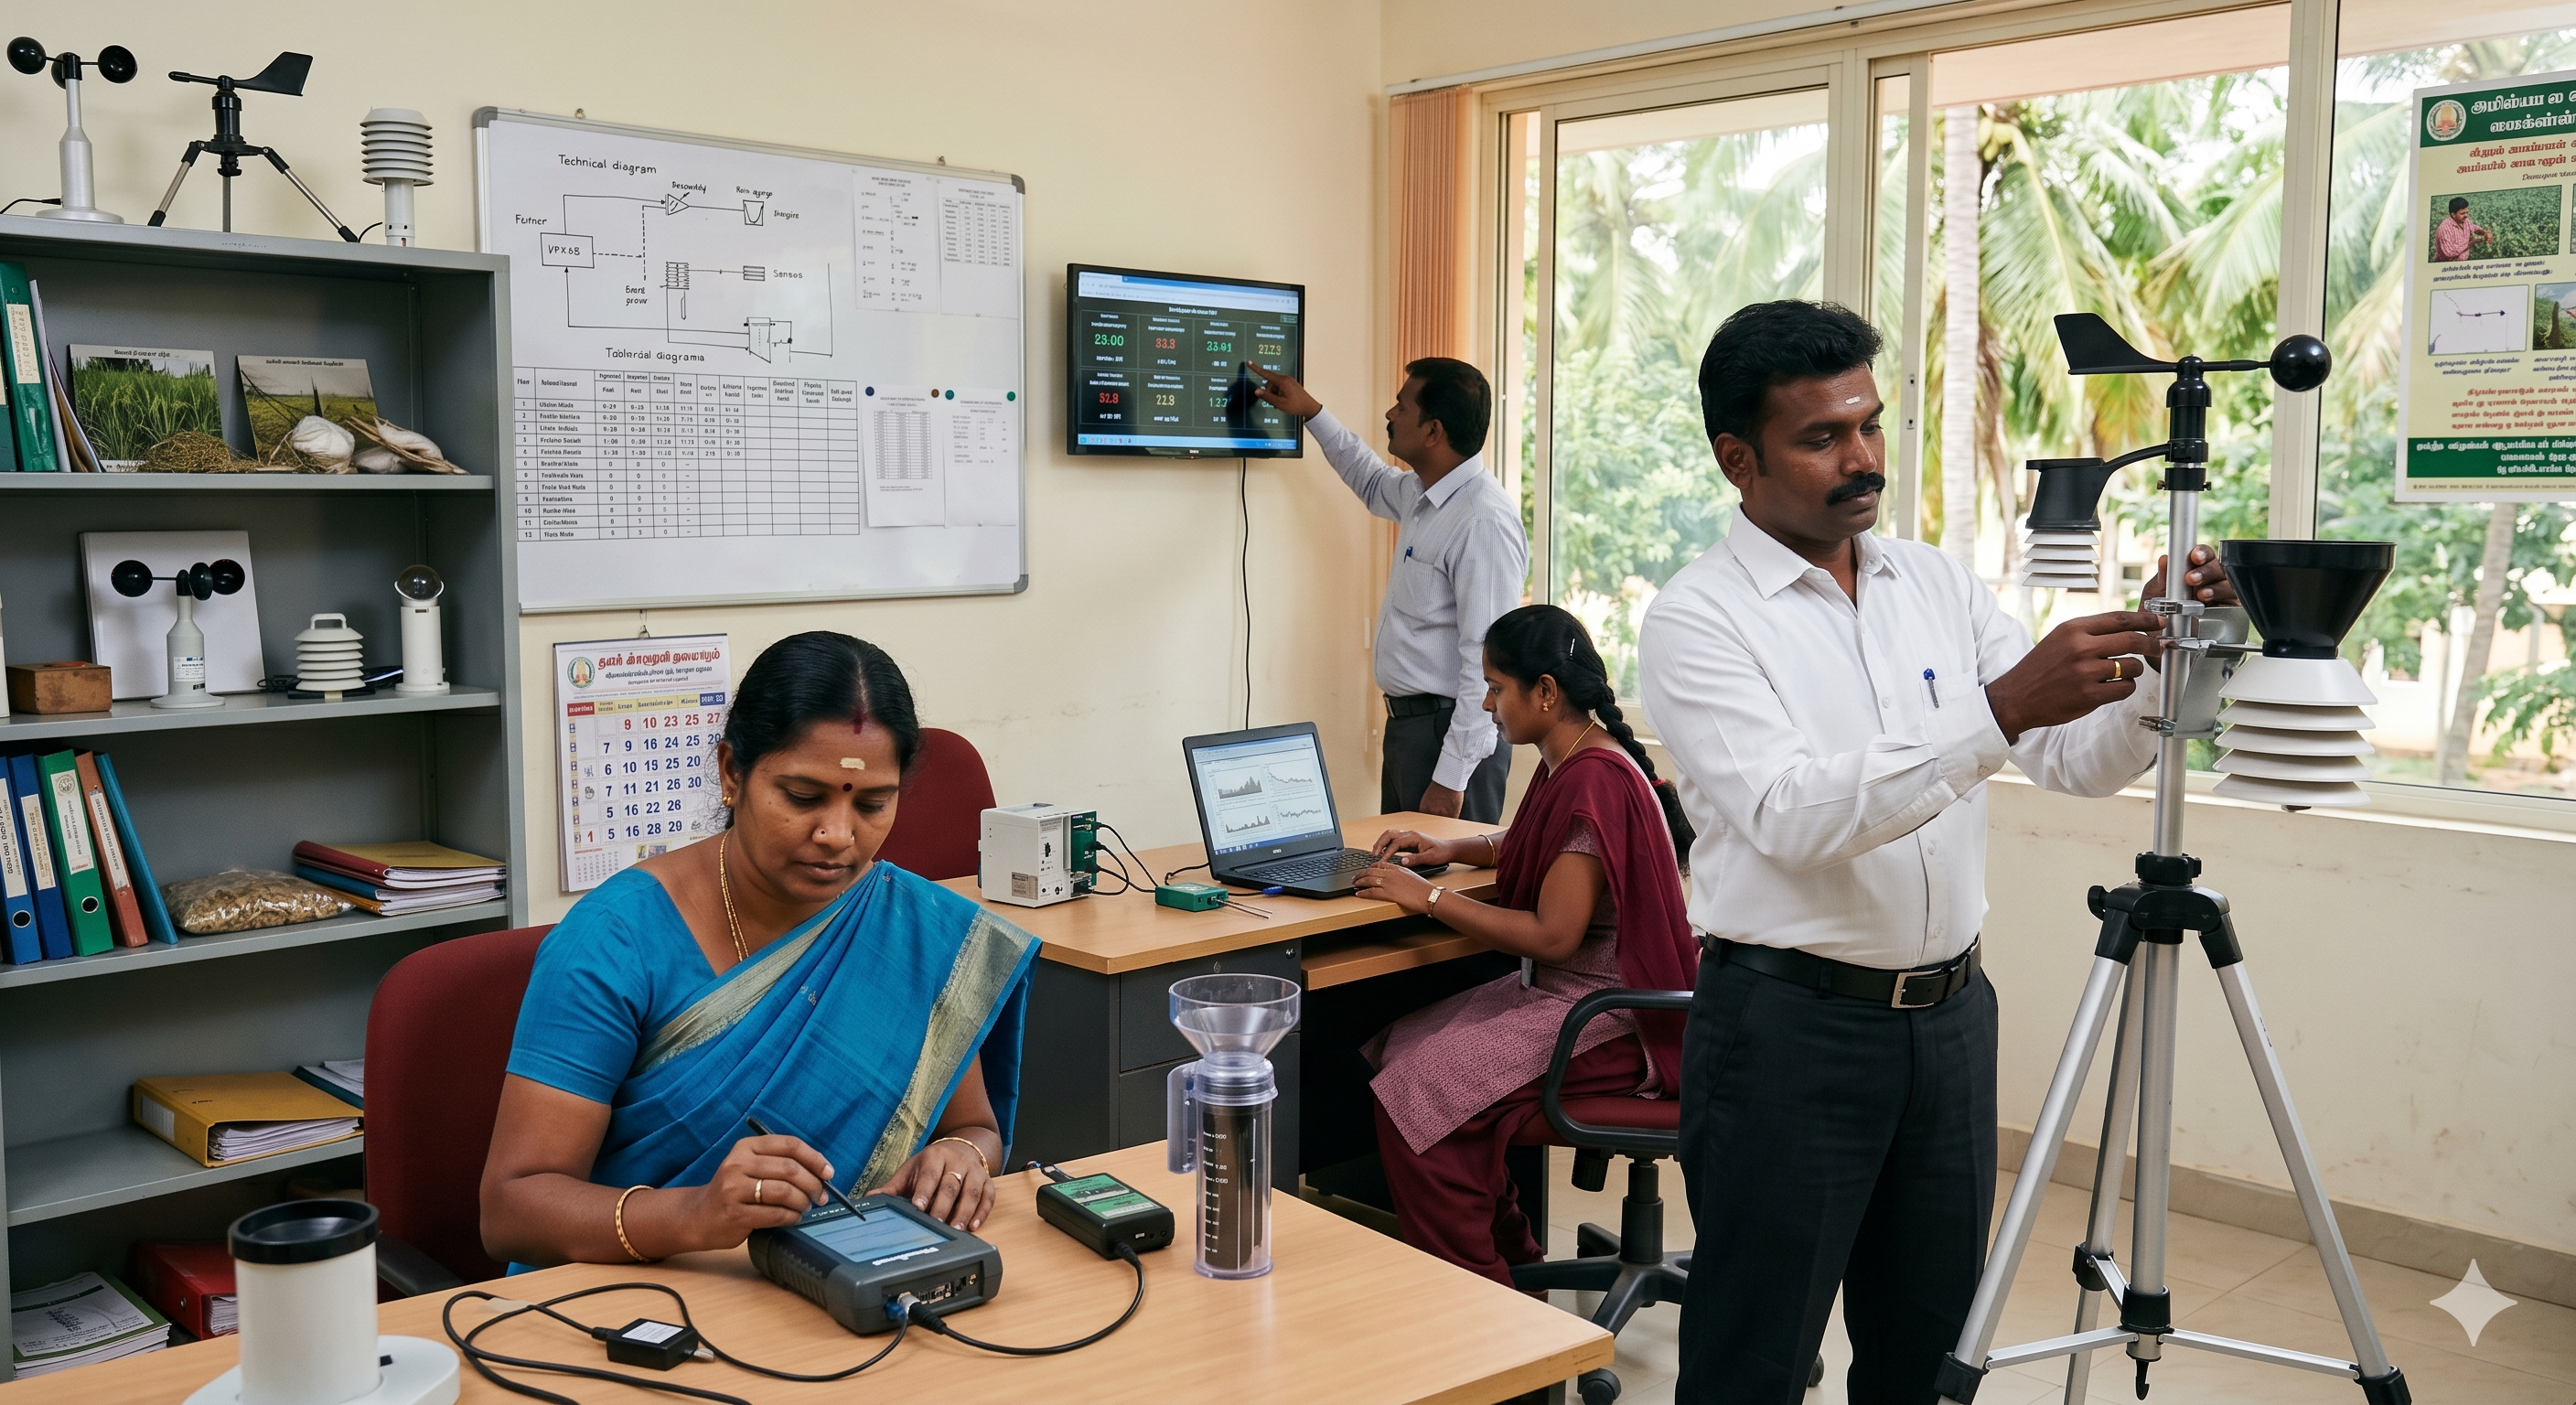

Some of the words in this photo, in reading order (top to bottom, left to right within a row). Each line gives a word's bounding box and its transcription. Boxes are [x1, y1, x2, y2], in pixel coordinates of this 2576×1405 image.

[558, 155, 606, 168] Technical
[613, 160, 656, 176] diagram
[643, 717, 657, 728] 10
[664, 715, 678, 727] 23
[685, 714, 700, 725] 25
[707, 713, 721, 724] 27
[604, 743, 610, 754] 7
[625, 740, 632, 752] 9
[644, 738, 658, 750] 16
[665, 736, 679, 748] 24
[686, 735, 700, 746] 25
[605, 764, 612, 776] 6
[623, 762, 637, 773] 10
[666, 758, 680, 769] 25
[687, 756, 701, 767] 20
[606, 786, 612, 797] 7
[624, 783, 637, 794] 11
[645, 781, 659, 792] 21
[667, 778, 681, 790] 26
[688, 777, 702, 788] 30
[606, 807, 613, 818] 5
[625, 804, 639, 816] 16
[646, 802, 660, 813] 22
[668, 799, 682, 810] 26
[587, 831, 594, 842] 1
[608, 829, 615, 840] 5
[626, 825, 639, 837] 16
[647, 823, 661, 834] 28
